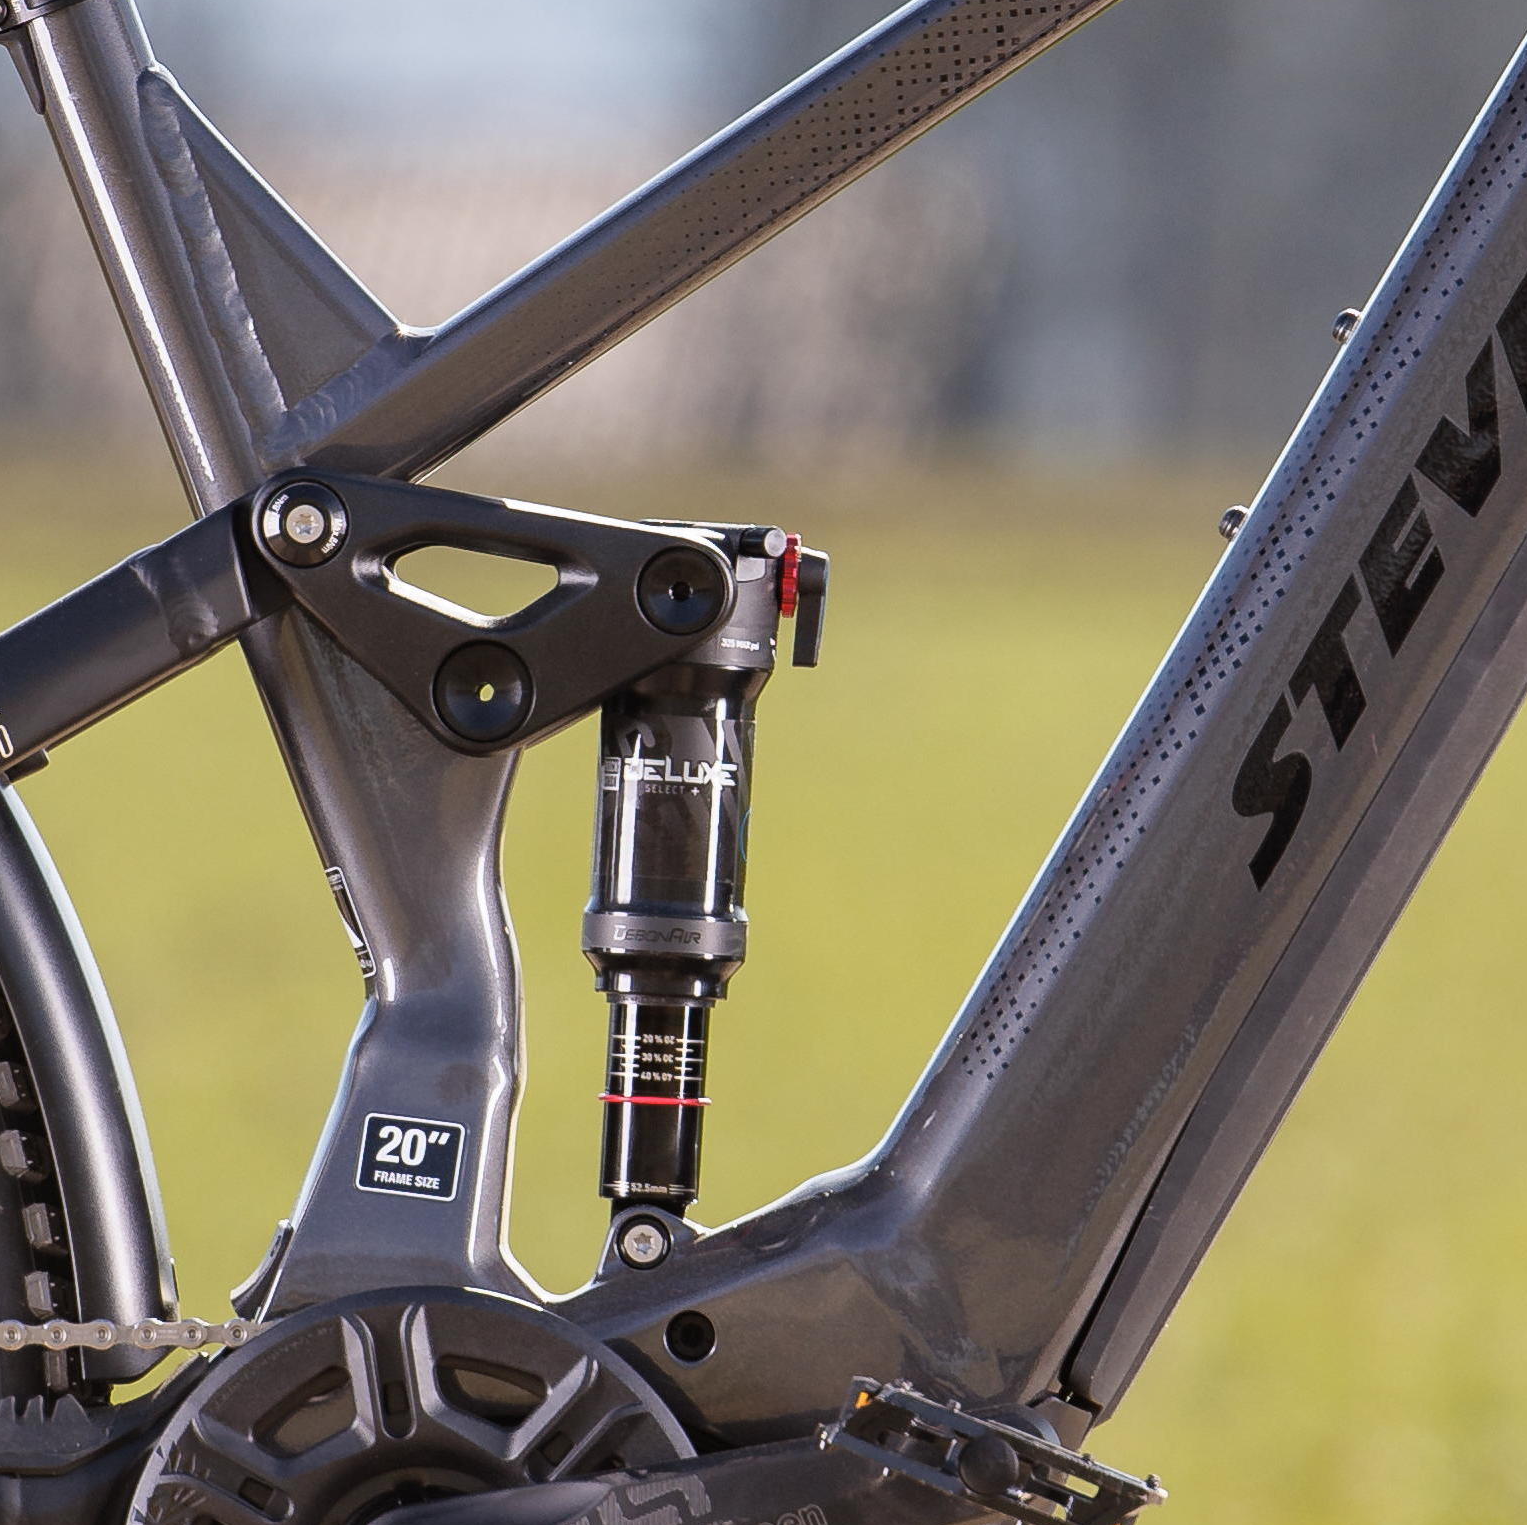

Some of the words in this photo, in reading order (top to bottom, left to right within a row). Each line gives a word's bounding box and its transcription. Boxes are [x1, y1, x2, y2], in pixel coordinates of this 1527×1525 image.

[644, 784, 685, 795] SELECT
[373, 1170, 414, 1186] FRAME
[414, 1175, 441, 1190] SIZE
